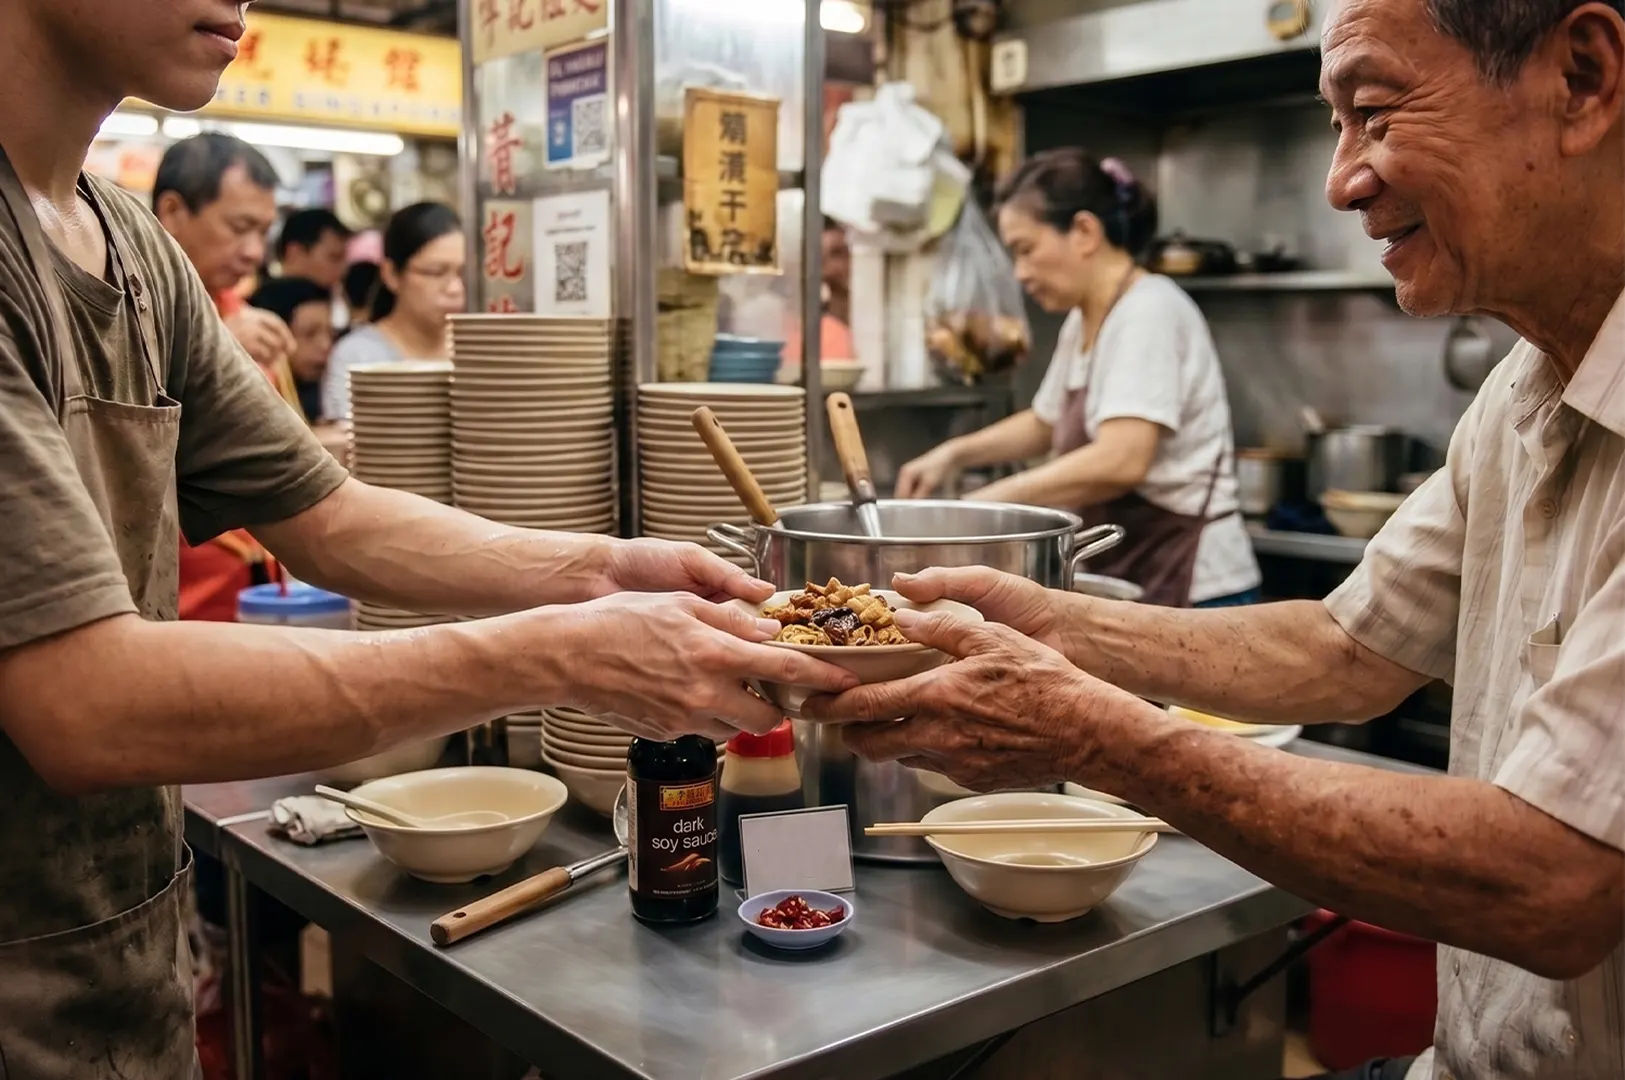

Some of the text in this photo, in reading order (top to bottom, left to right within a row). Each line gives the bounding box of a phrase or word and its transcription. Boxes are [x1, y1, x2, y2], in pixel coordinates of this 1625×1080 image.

[673, 816, 704, 834] dark
[651, 828, 718, 853] soy sauce
